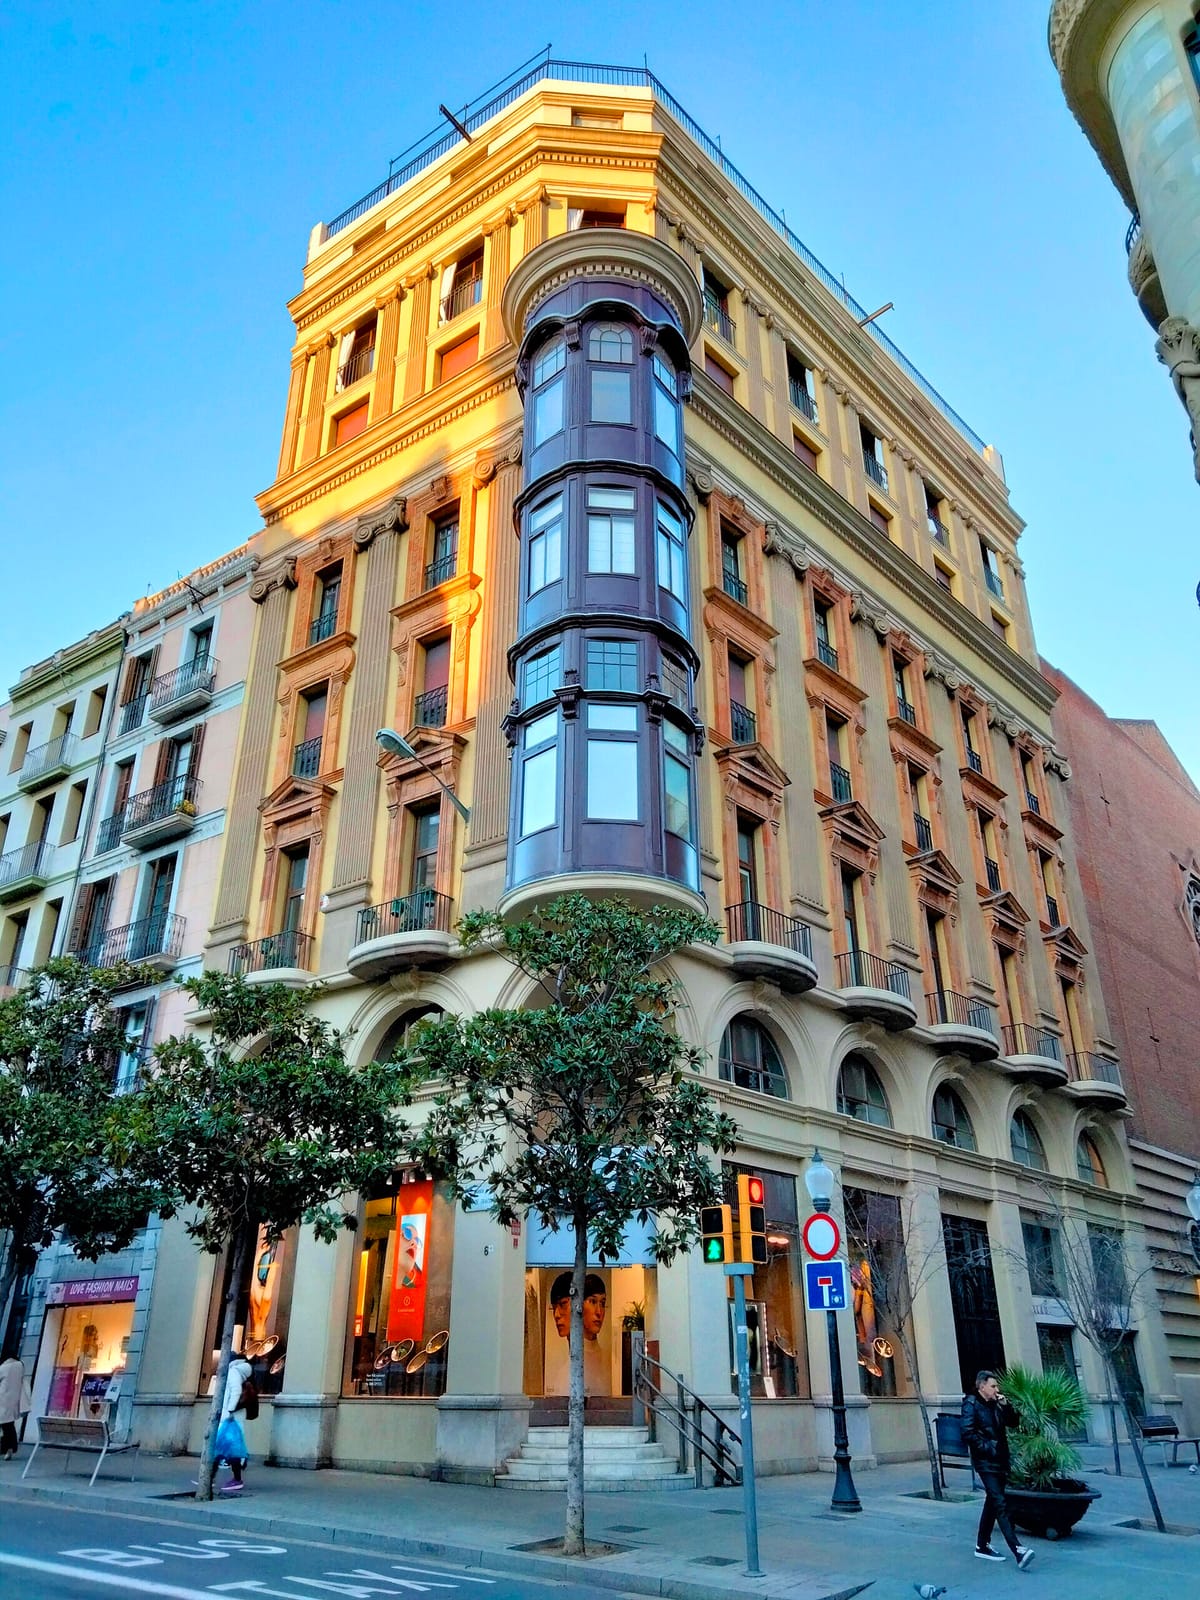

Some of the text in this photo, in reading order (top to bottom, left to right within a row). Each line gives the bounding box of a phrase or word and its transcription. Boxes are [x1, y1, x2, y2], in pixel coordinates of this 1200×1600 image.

[69, 1279, 135, 1295] LOVE FASHION NAILS
[57, 1539, 287, 1567] BUS
[205, 1565, 497, 1600] TAXI
